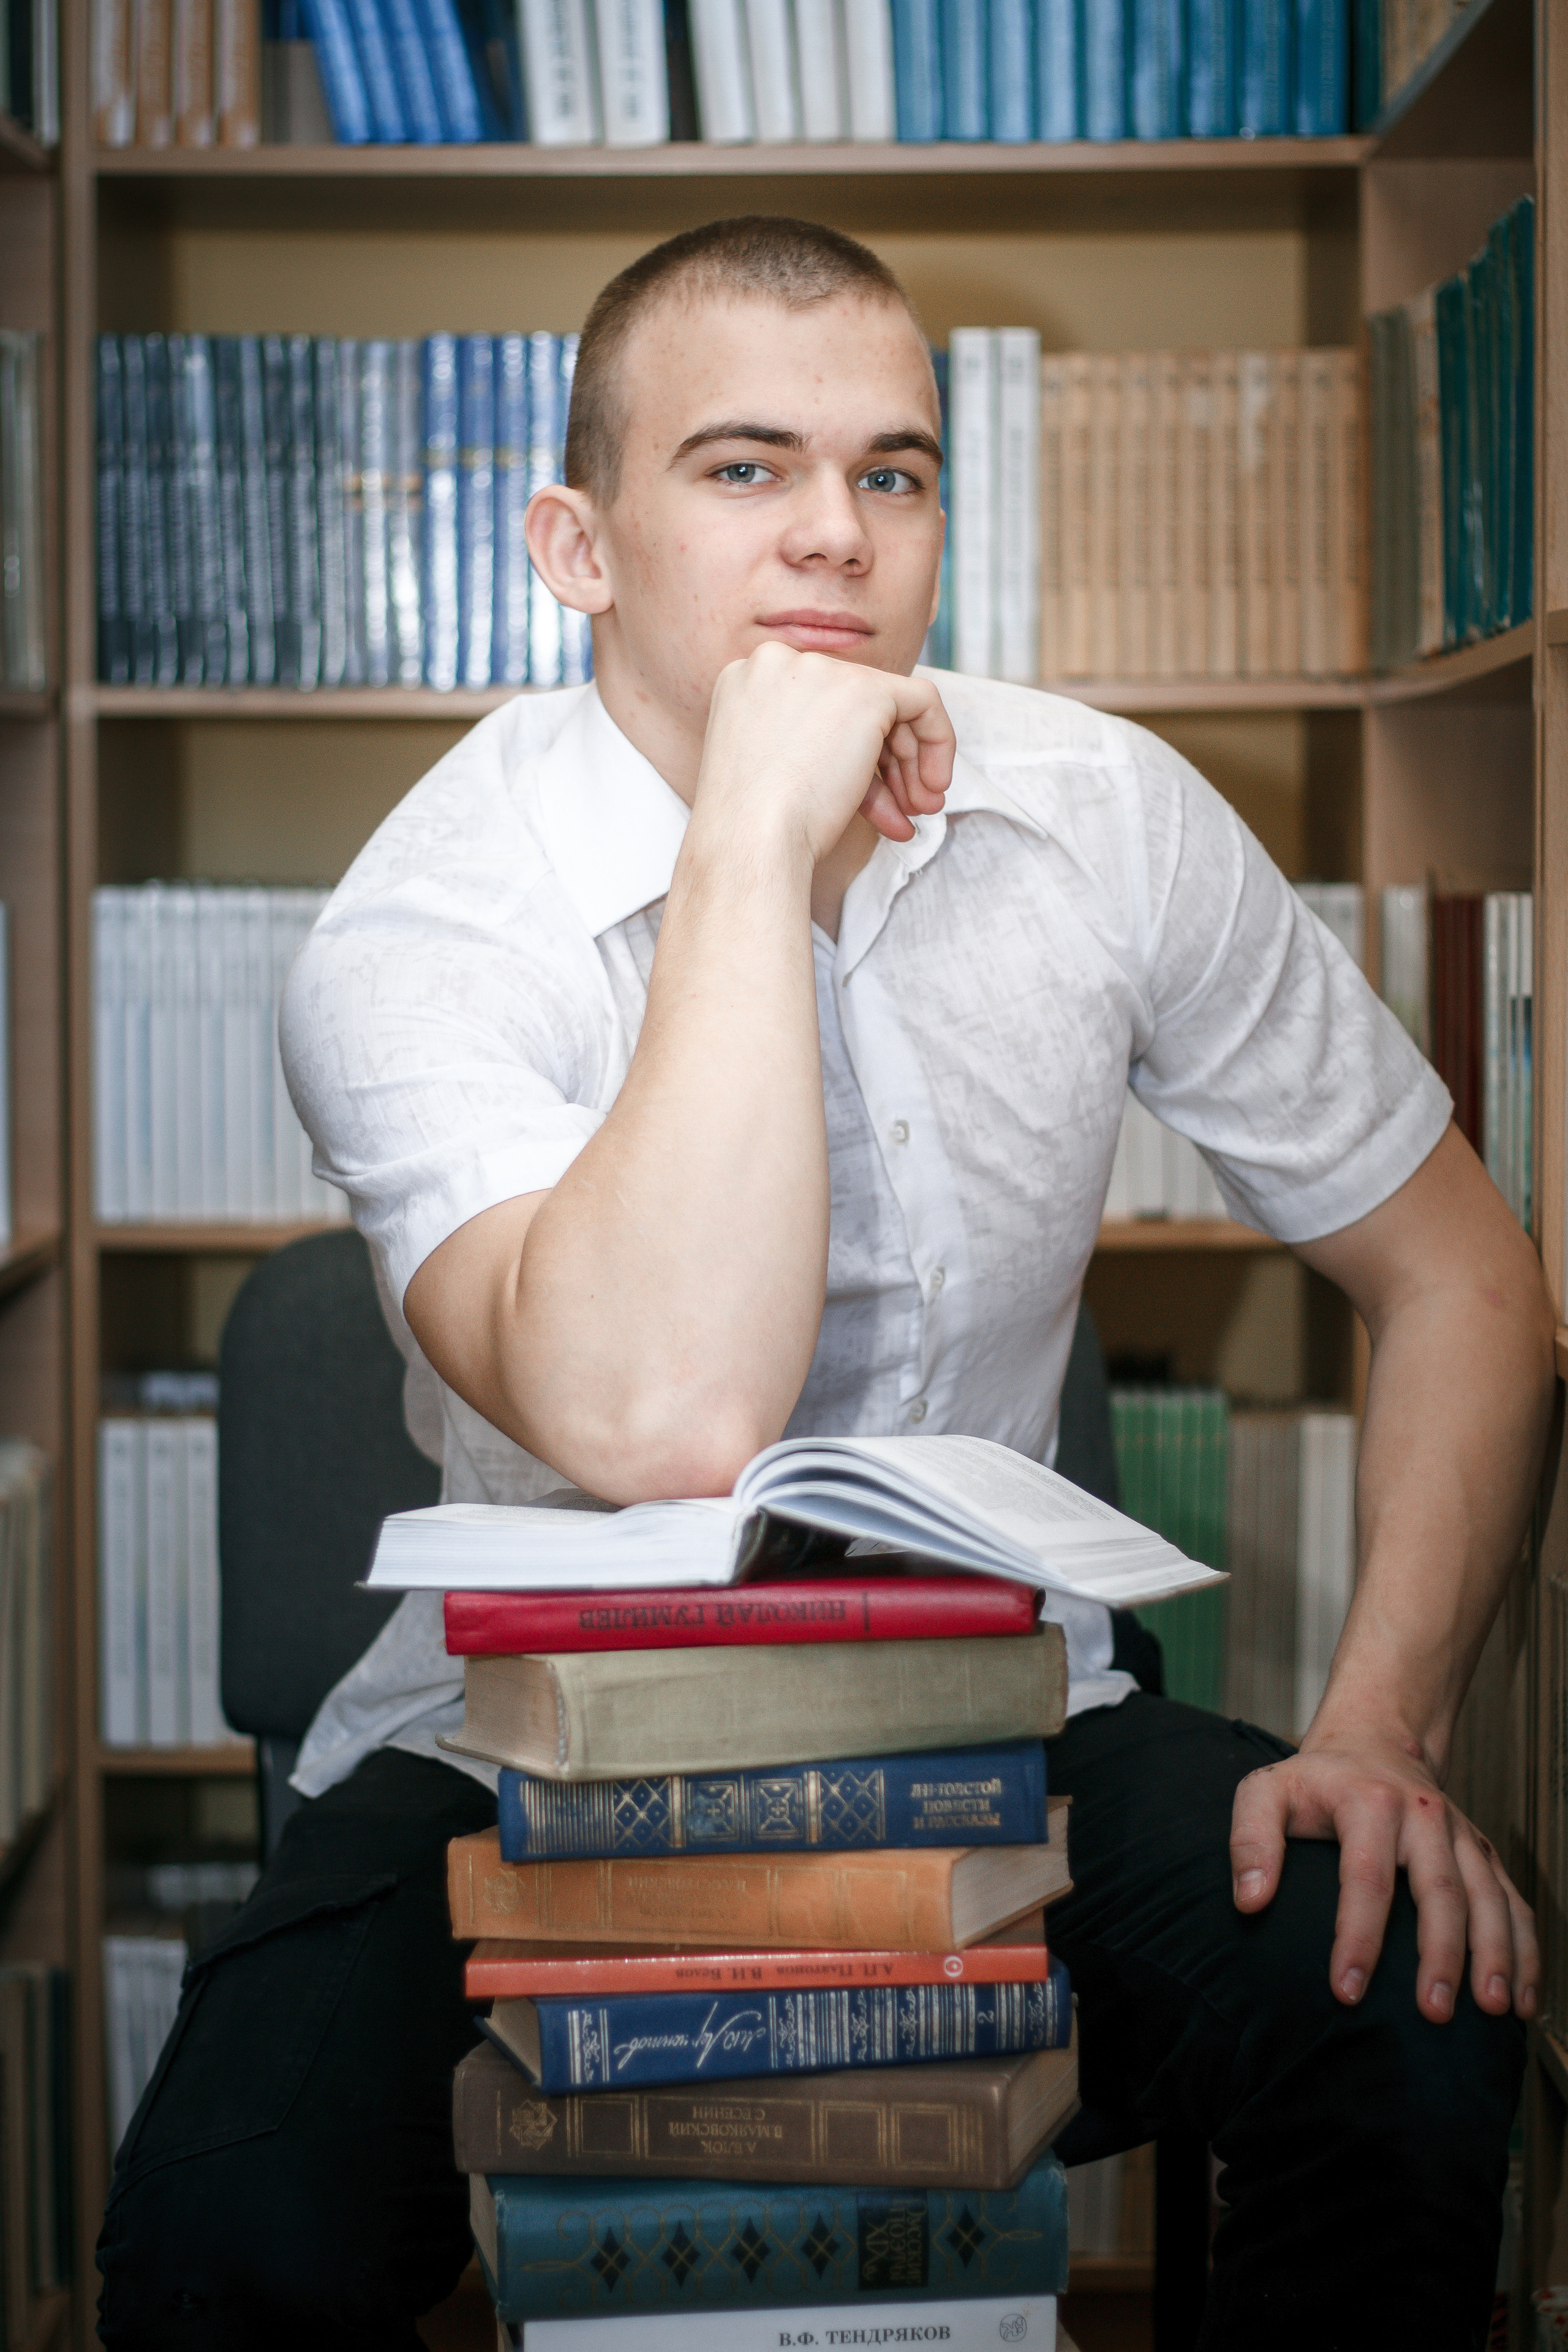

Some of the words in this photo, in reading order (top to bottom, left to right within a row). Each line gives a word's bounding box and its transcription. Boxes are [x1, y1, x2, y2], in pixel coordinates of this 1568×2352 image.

[578, 1604, 705, 1629] ГУМИЛЕВ
[715, 1599, 846, 1626] НИКОЛАЙ
[922, 1798, 990, 1814] ПОВЕСТИ
[676, 1966, 722, 1981] Белов
[775, 1963, 853, 1977] Платонов
[977, 2010, 994, 2024] 2
[778, 2331, 820, 2346] В.Ф.
[826, 2326, 951, 2346] ТЕНДРЯКОВ
